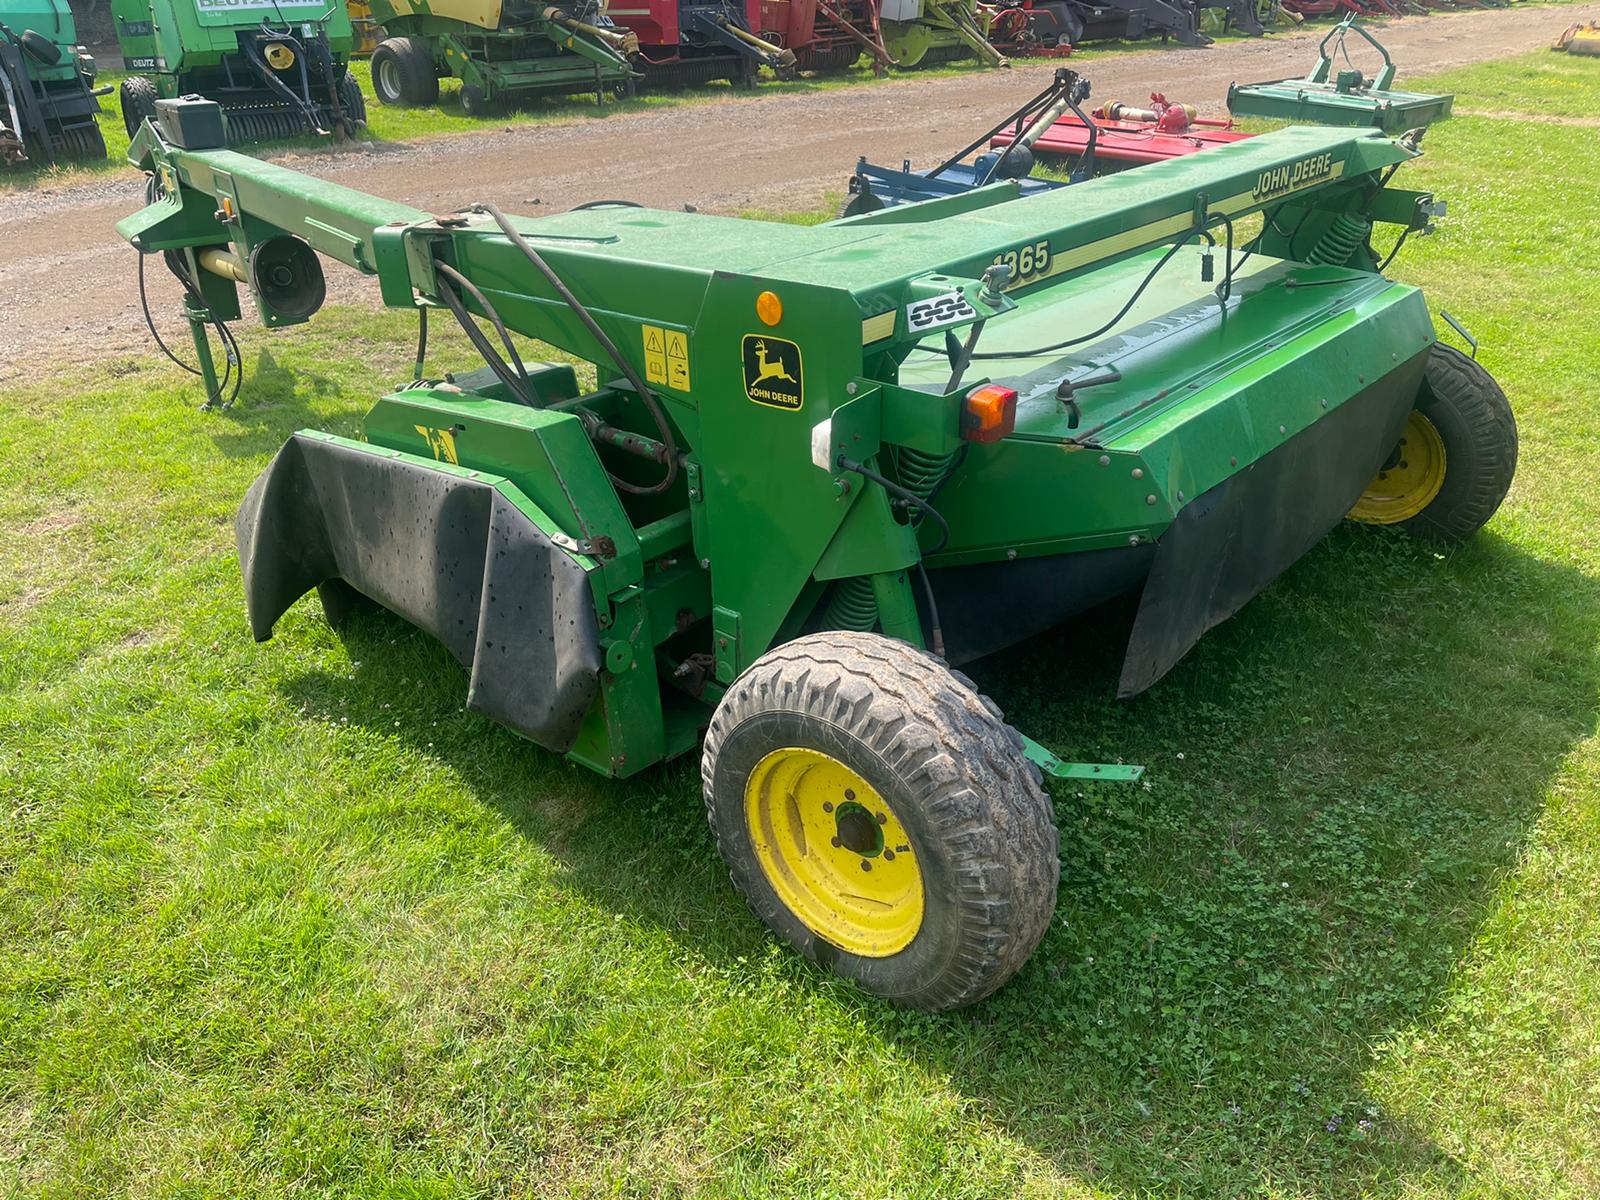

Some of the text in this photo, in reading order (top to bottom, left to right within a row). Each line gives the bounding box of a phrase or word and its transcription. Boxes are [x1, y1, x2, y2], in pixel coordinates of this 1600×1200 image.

[132, 58, 155, 67] DEUTZ
[1253, 152, 1332, 196] JOHN DEERE
[749, 387, 799, 405] JOHN DEERE
